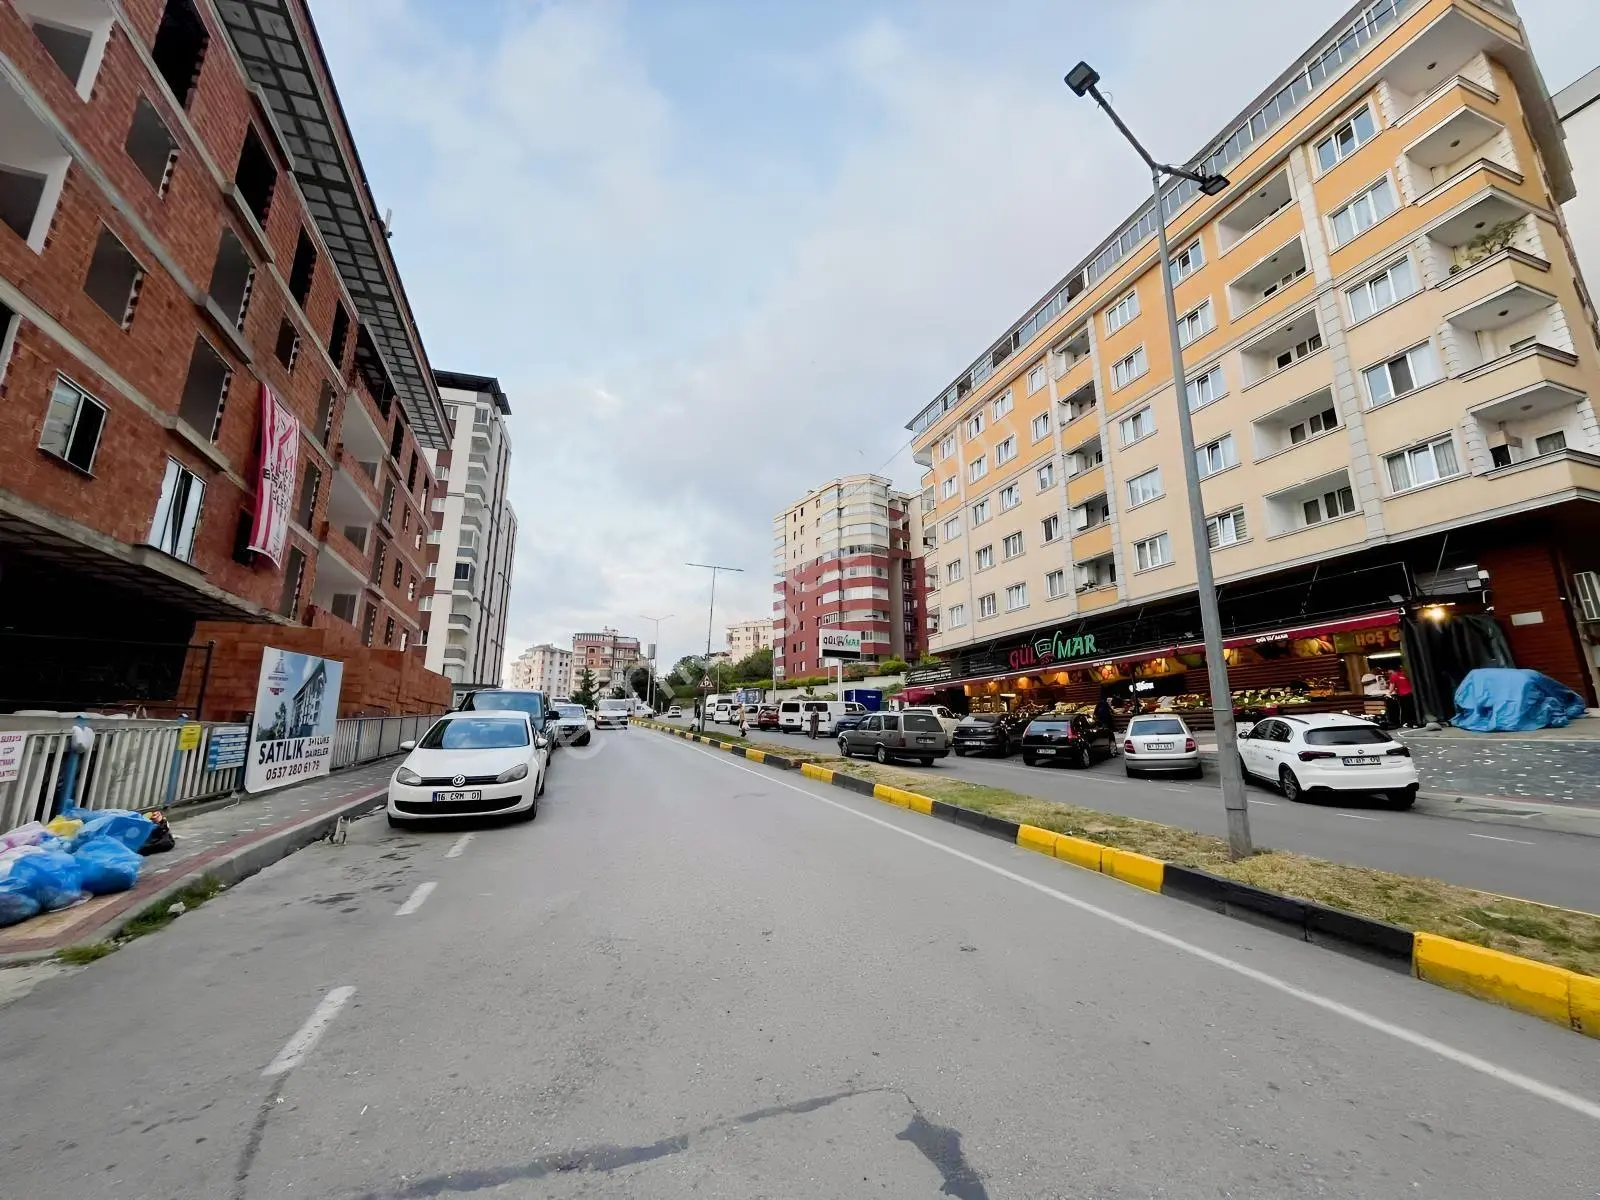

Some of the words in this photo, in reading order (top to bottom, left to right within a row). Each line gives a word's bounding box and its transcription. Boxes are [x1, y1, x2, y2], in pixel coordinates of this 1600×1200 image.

[1010, 643, 1036, 670] GÜL
[1057, 634, 1096, 660] MAR
[259, 739, 304, 765] SATILIK
[266, 766, 287, 780] 0537
[288, 763, 302, 776] 280
